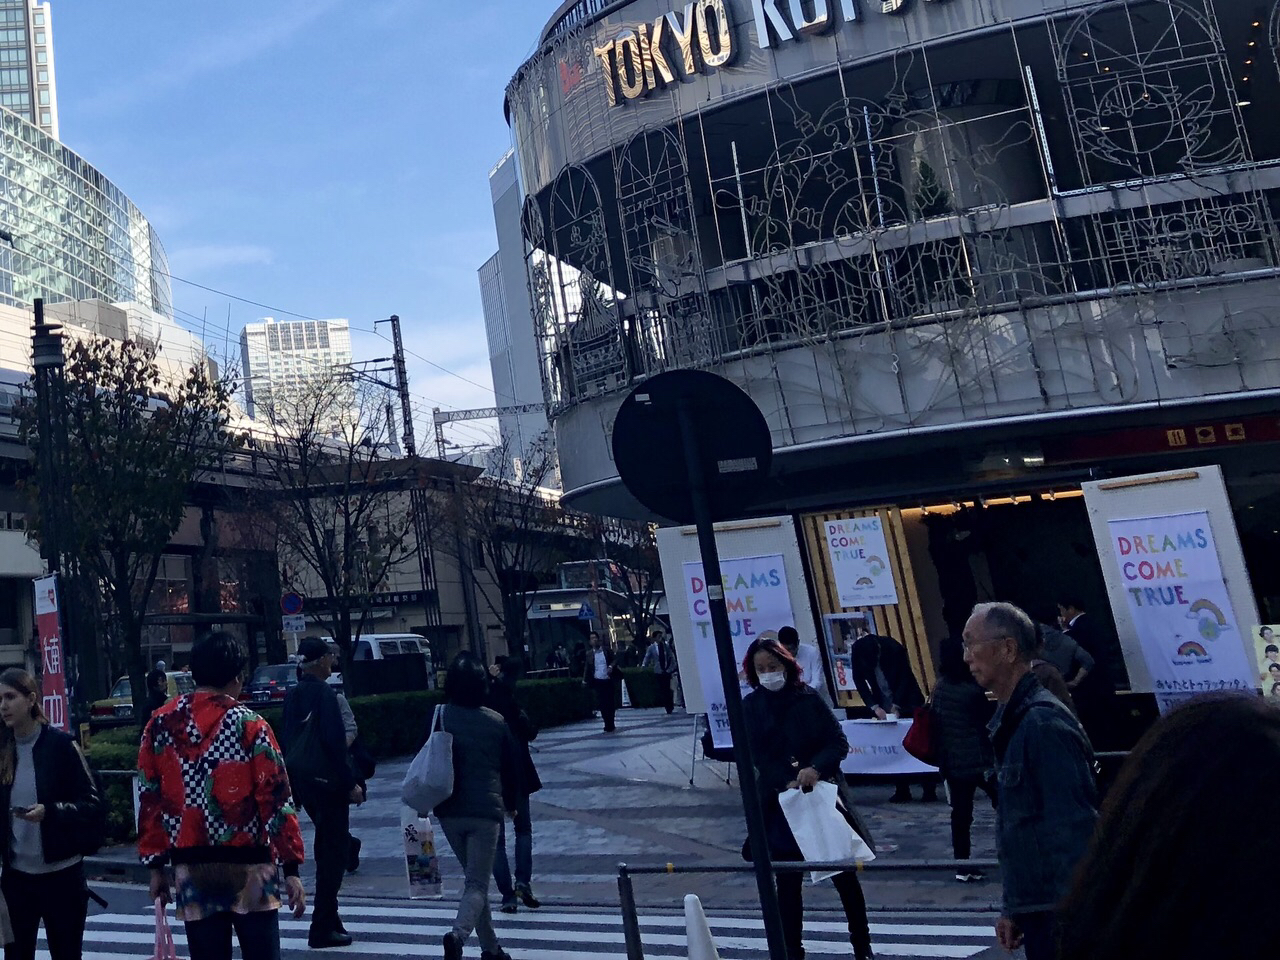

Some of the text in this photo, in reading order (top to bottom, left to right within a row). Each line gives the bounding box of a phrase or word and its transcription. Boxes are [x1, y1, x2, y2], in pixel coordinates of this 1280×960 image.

[829, 520, 879, 535] DREAMS
[831, 536, 866, 548] COME
[1118, 528, 1207, 556] DREAMS
[834, 548, 866, 561] TRUE
[1123, 558, 1189, 581] COME
[690, 568, 781, 594] DEAMS
[693, 595, 757, 616] CME
[1128, 585, 1189, 607] TRUE
[696, 618, 756, 639] TUE
